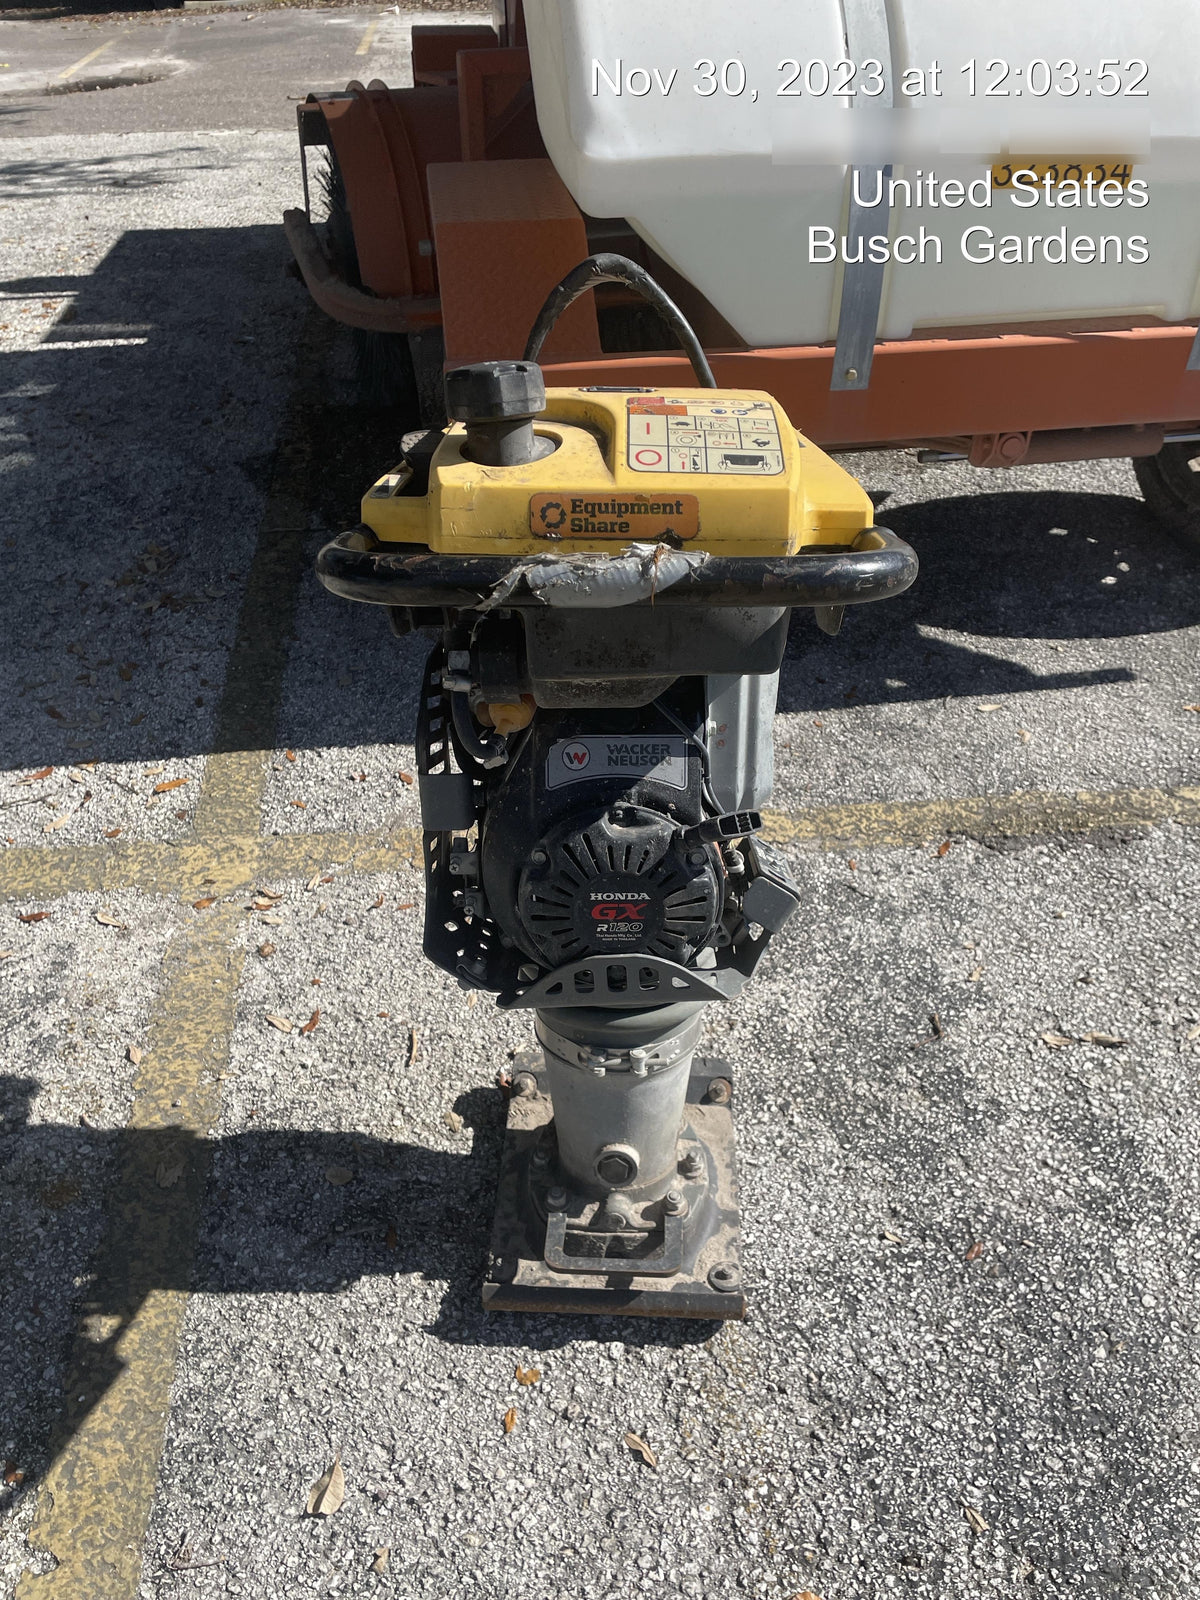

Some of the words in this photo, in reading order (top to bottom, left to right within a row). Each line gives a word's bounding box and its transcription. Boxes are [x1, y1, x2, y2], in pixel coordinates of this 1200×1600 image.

[570, 499, 683, 518] Equipment
[570, 518, 630, 533] Share
[606, 743, 671, 755] WACKER
[607, 755, 672, 767] NEUSON
[589, 892, 651, 900] HONDA
[591, 902, 648, 919] GX
